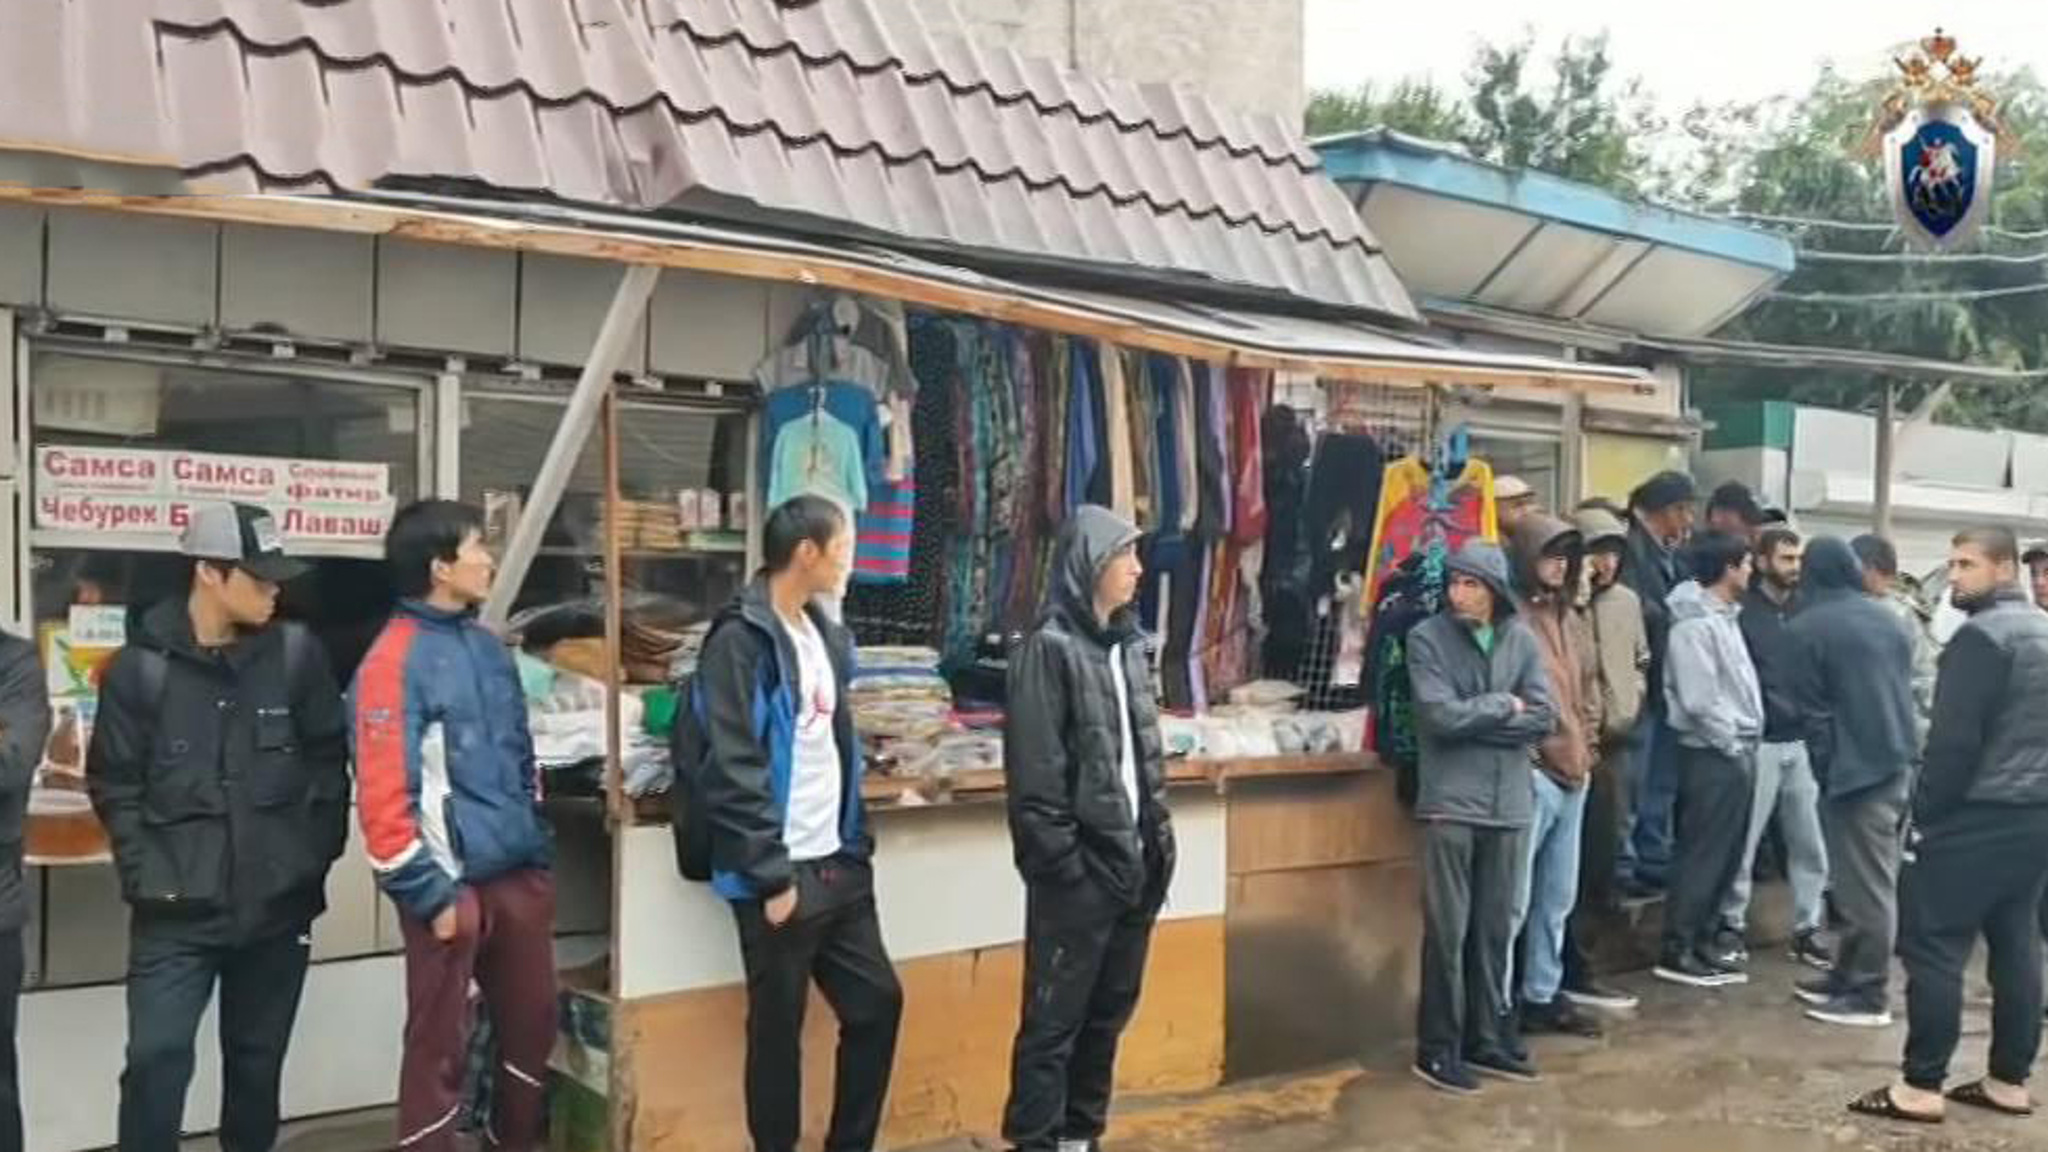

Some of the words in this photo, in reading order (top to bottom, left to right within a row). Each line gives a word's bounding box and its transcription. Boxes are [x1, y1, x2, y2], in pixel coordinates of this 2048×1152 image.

[44, 451, 155, 478] Самса
[173, 458, 275, 485] Самса
[41, 497, 158, 529] Чебурек
[282, 508, 381, 536] Лаваш
